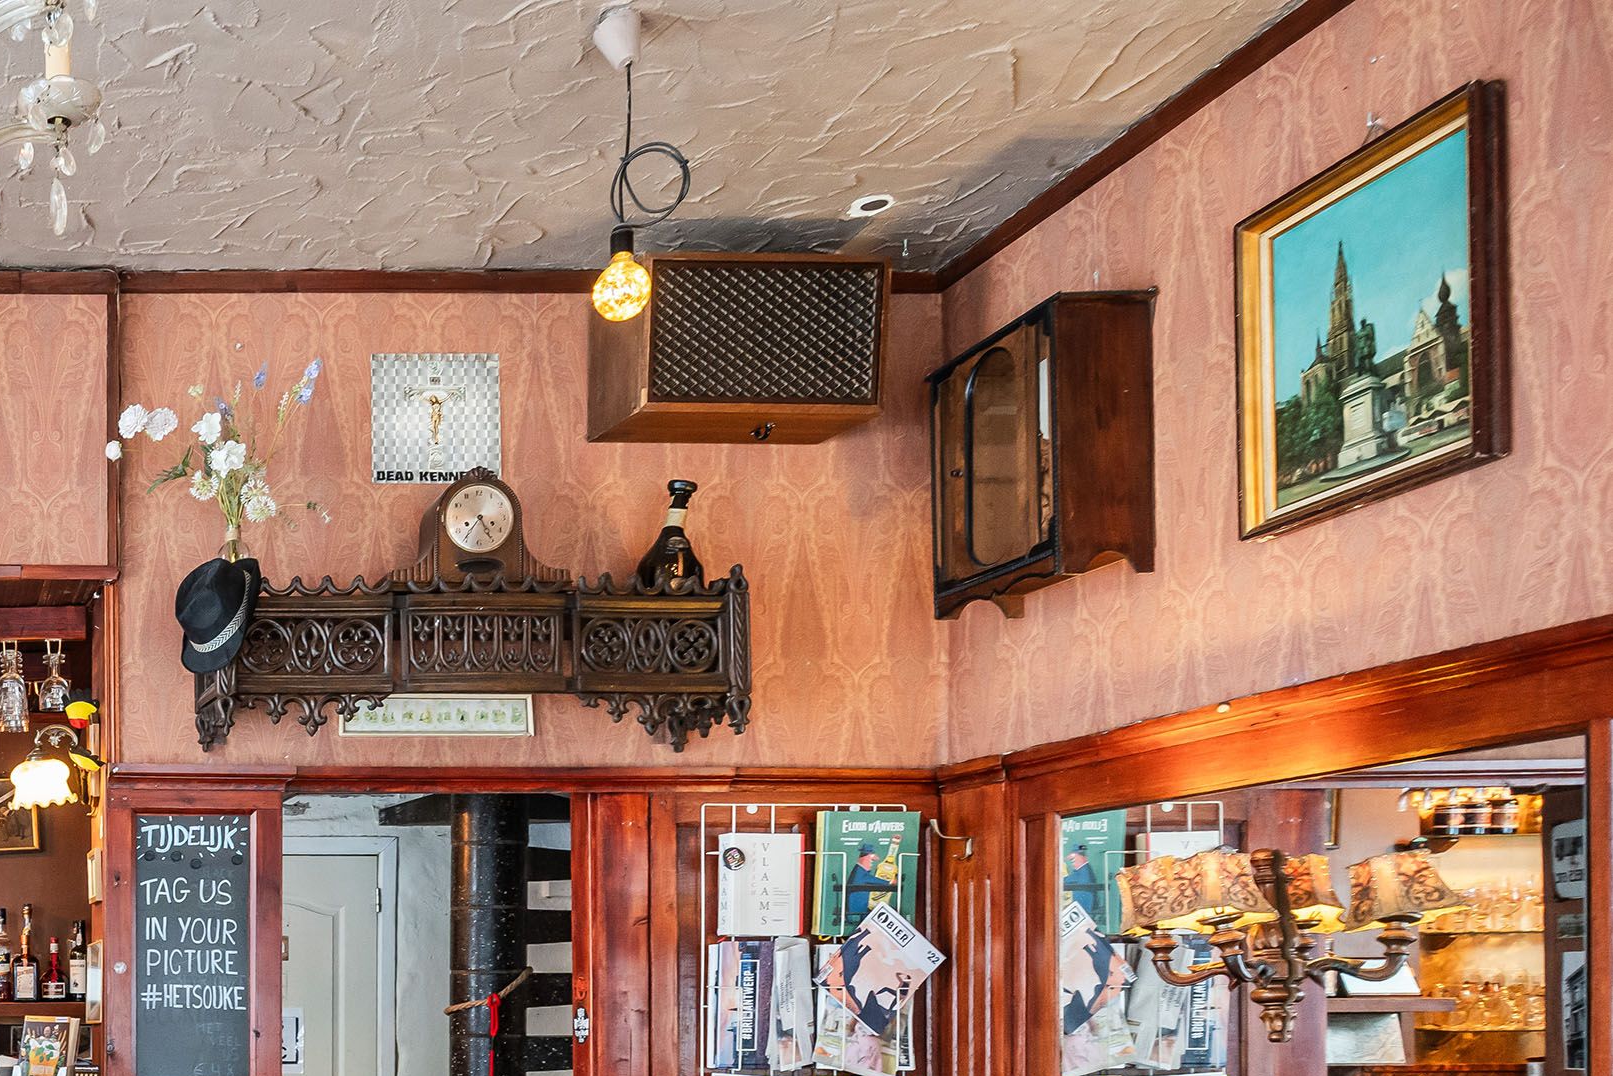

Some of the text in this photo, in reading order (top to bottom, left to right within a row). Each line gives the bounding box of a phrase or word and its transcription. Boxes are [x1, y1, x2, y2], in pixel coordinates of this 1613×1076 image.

[377, 471, 414, 481] DEAD
[141, 824, 237, 853] TIJDELIJK
[140, 877, 232, 906] TAG US
[759, 842, 770, 925] VLAAMS
[145, 917, 237, 945] IN YOUR
[146, 948, 238, 977] PICTURE
[140, 984, 246, 1011] #HETSOUKE
